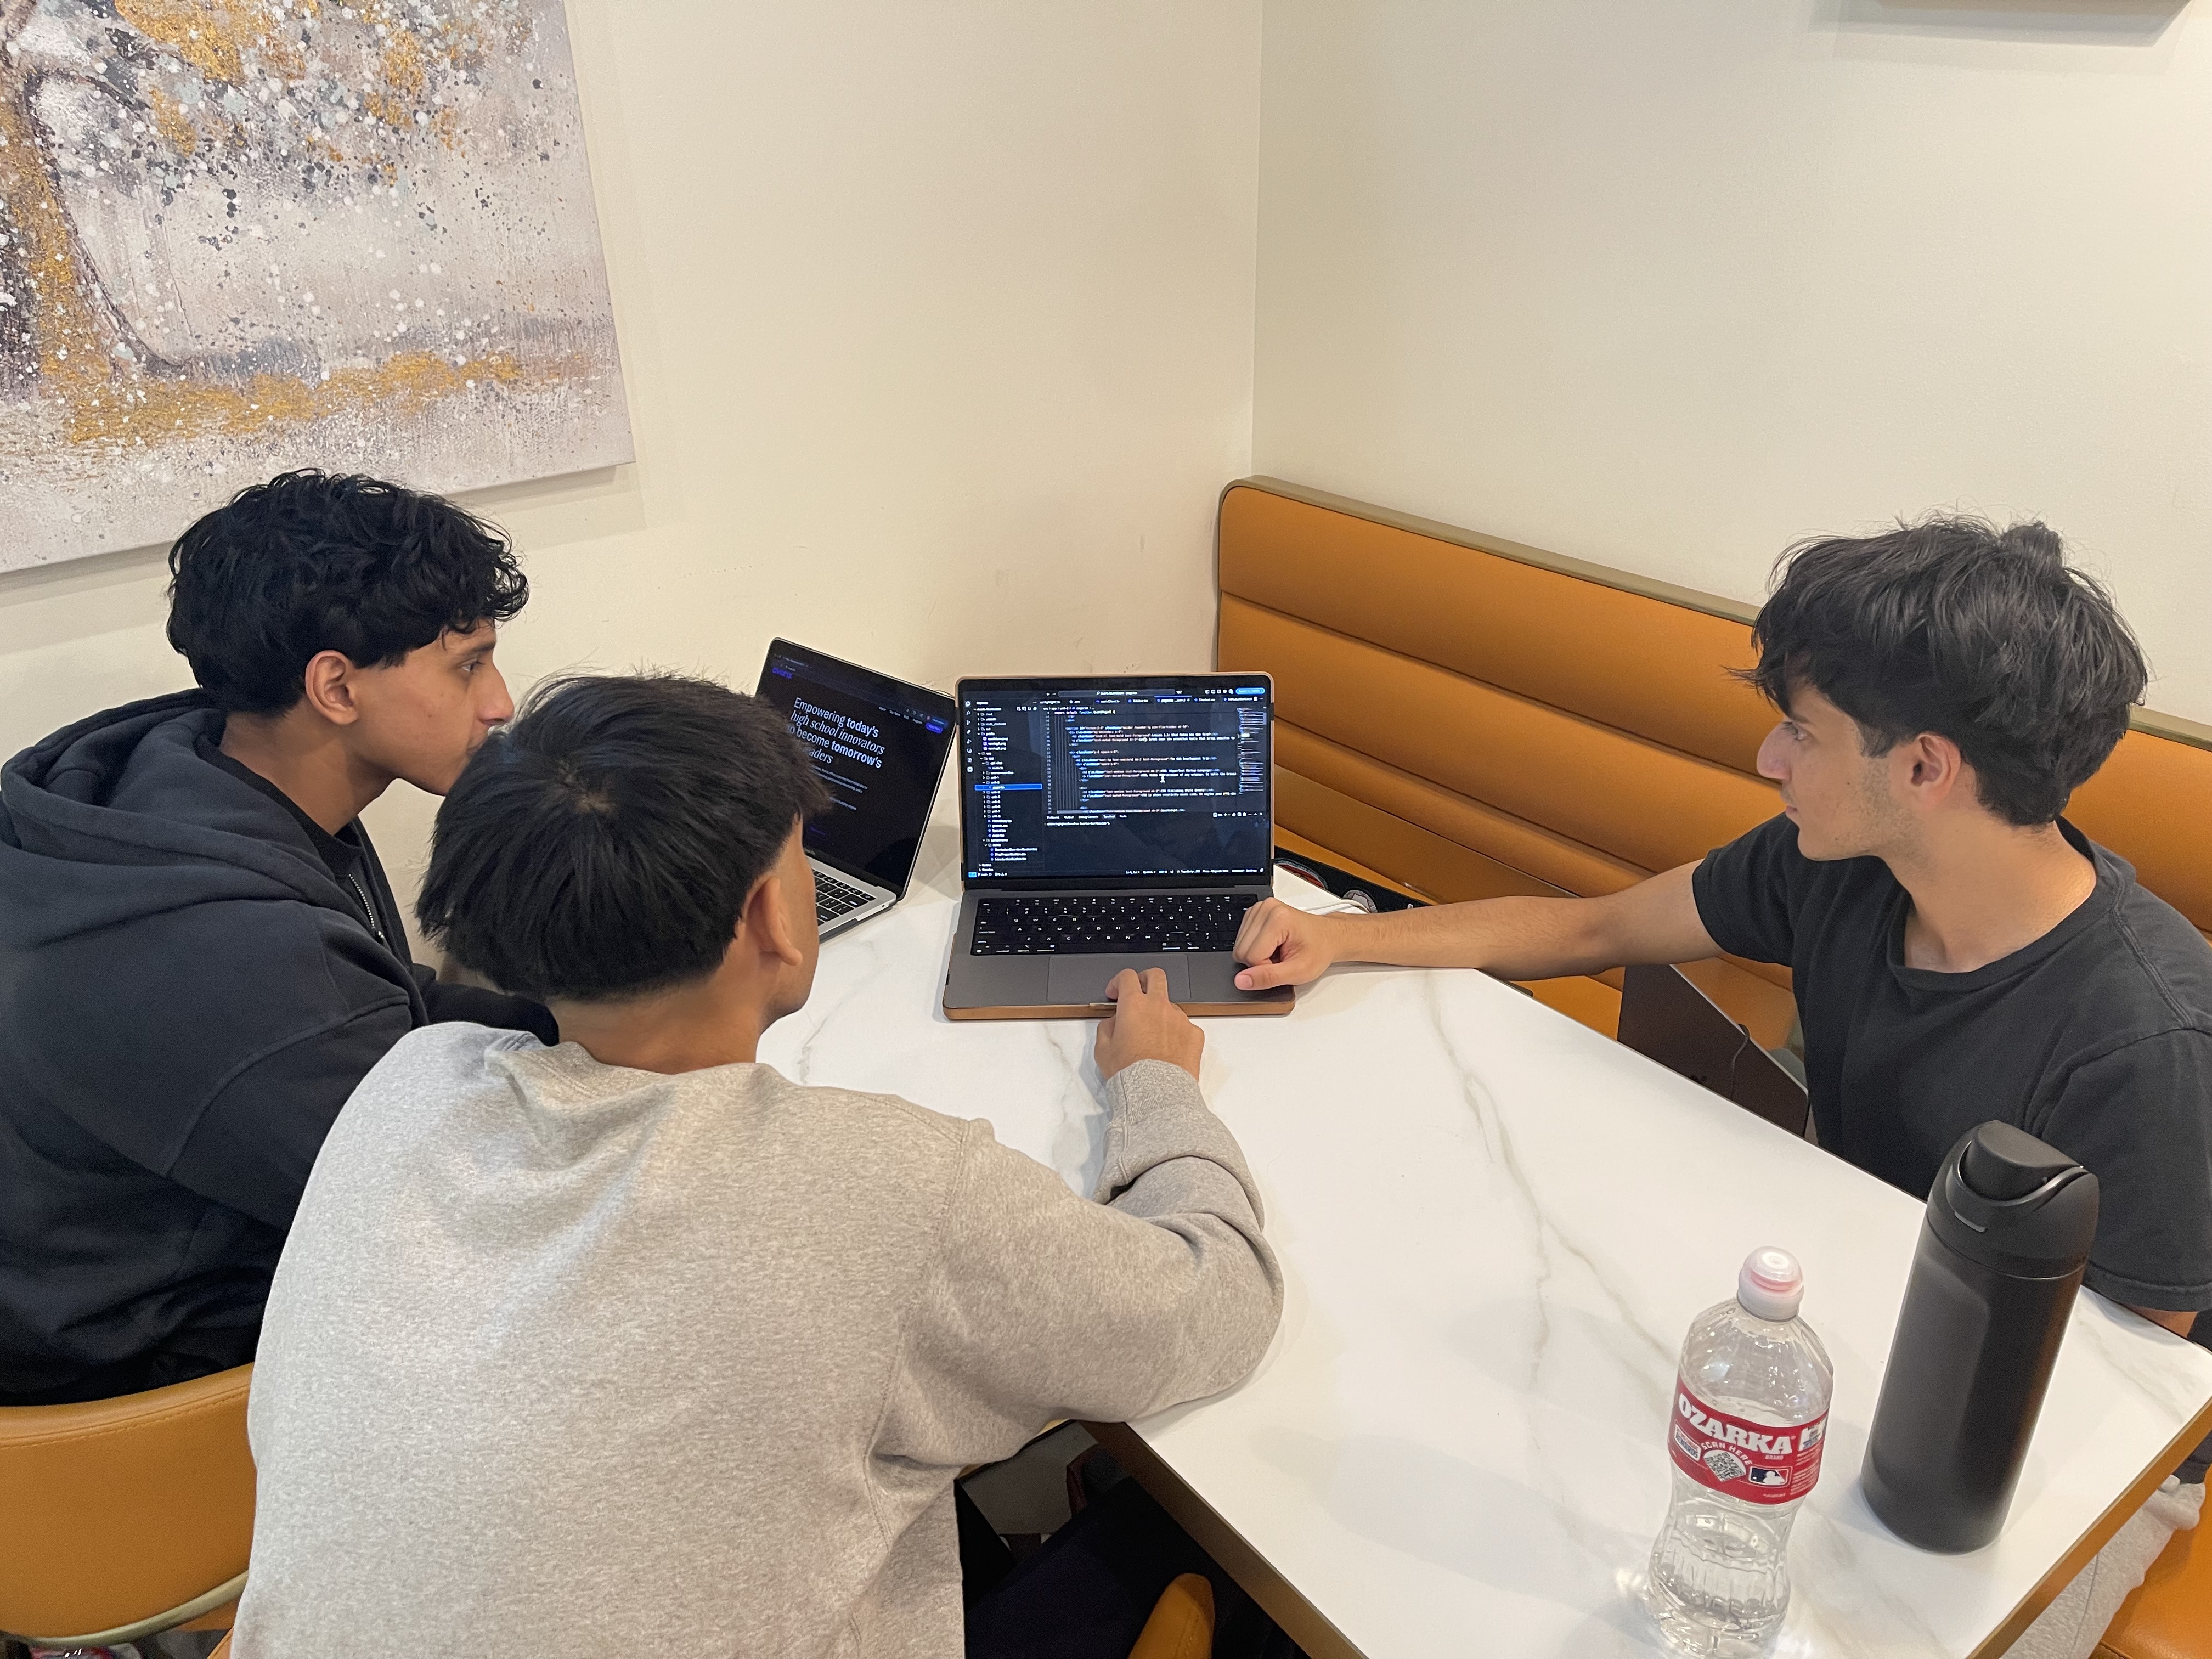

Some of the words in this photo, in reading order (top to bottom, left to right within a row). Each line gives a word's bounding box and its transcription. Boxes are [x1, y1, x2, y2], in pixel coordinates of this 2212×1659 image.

[791, 710, 810, 727] high
[809, 720, 839, 737] school
[838, 729, 885, 755] innovators
[794, 697, 845, 727] Empowering
[847, 718, 879, 737] today's
[797, 726, 830, 748] become
[831, 741, 882, 768] tomorrow's
[804, 747, 833, 764] aders
[1679, 1393, 1792, 1454] OZARKA
[1701, 1441, 1726, 1450] SCAN
[1729, 1446, 1753, 1465] HERE
